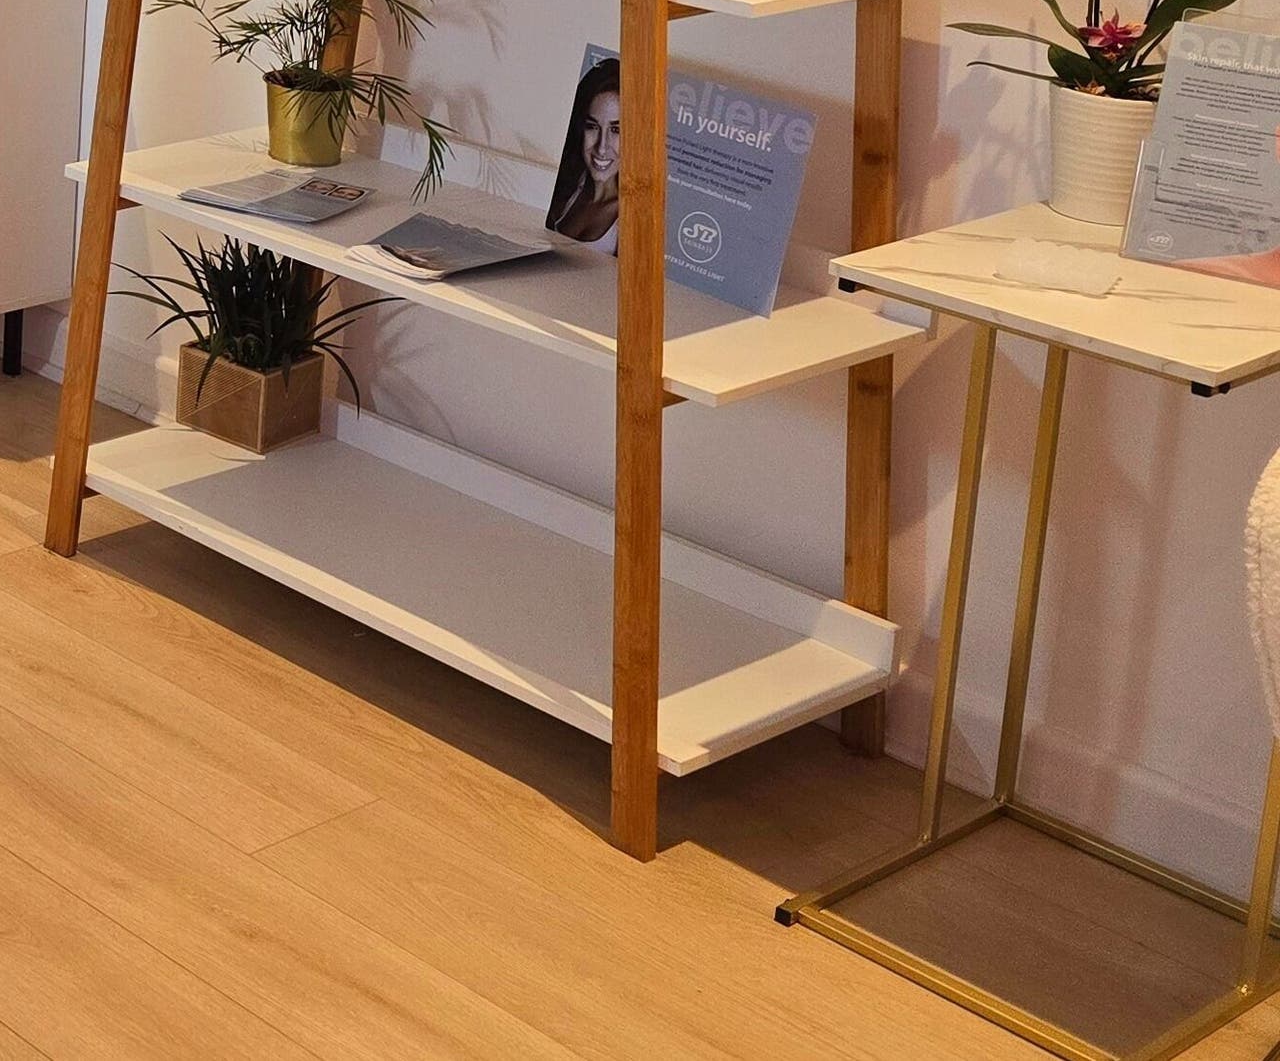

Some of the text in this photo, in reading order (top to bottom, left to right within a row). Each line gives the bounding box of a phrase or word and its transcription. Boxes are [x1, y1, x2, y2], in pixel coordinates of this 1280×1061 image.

[668, 81, 814, 154] elieve
[676, 105, 772, 153] In yourself.
